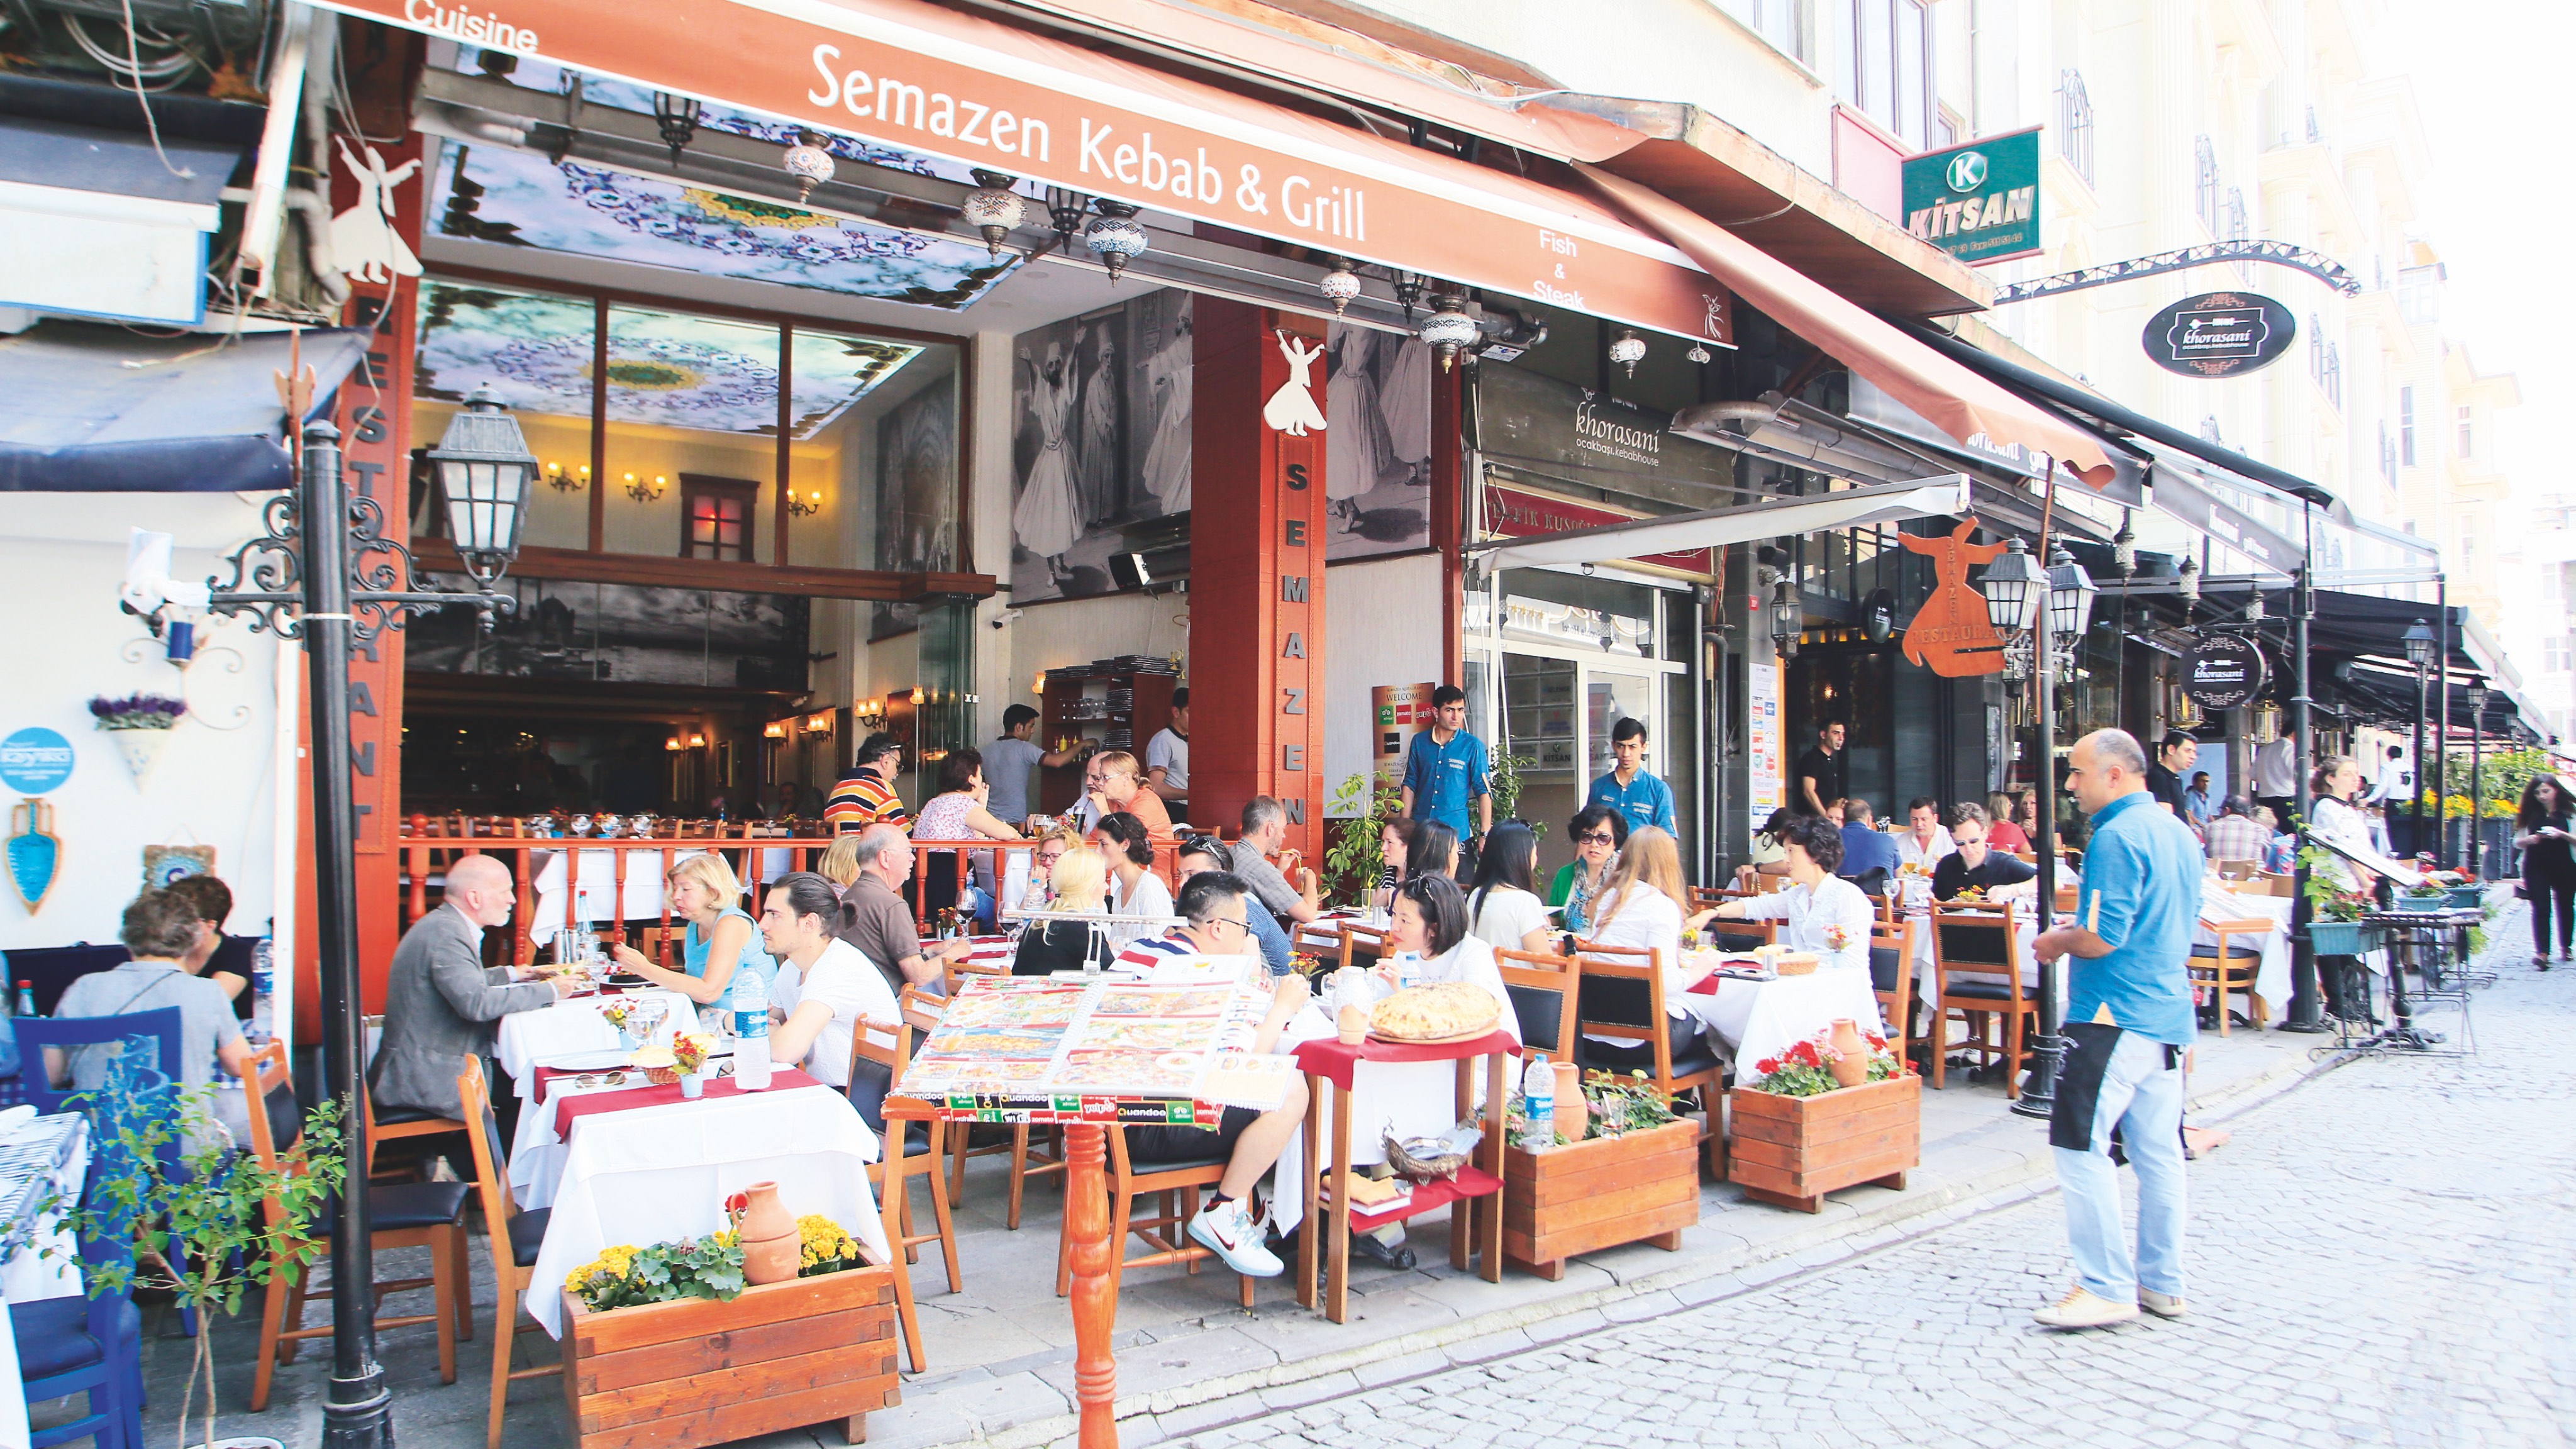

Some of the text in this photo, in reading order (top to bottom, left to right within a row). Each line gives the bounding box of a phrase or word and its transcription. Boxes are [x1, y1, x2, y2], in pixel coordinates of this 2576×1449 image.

[404, 0, 538, 53] Cuisine
[807, 44, 1365, 243] Semazen Kebab & Grill
[1955, 156, 1979, 187] K
[1907, 185, 2035, 241] KİTSAN
[1540, 229, 1577, 258] Fish
[1554, 263, 1565, 279] &
[1533, 280, 1586, 309] Steak
[2182, 330, 2252, 344] khorasani
[1575, 401, 1660, 453] khorasani
[1576, 438, 1659, 467] ocakbaşı.kebabhouse
[1283, 463, 1308, 826] SEMAZEN
[1386, 692, 1422, 702] WELCOME
[1001, 1093, 1048, 1102] Quandoo
[1084, 1103, 1106, 1114] yelp
[1118, 1108, 1167, 1117] Quandoo
